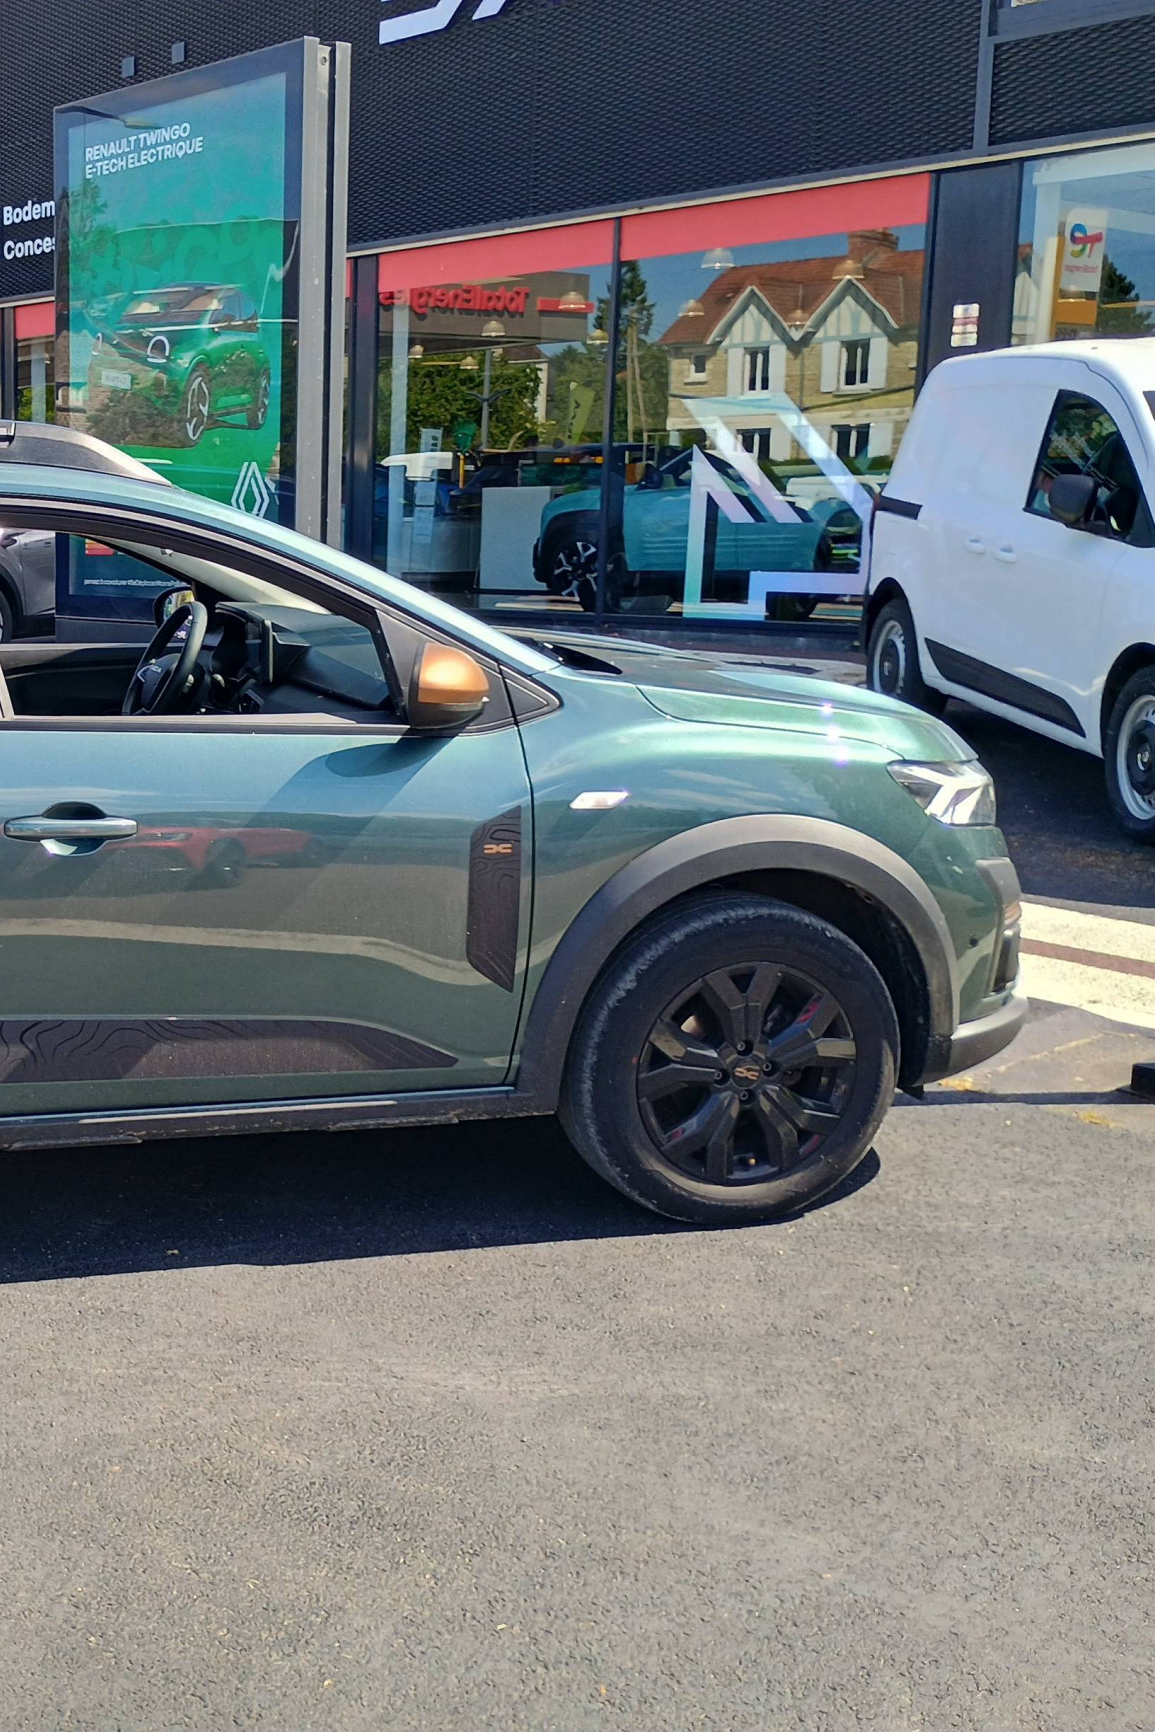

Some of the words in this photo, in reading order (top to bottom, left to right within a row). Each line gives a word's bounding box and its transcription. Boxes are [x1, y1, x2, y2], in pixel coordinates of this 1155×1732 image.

[85, 135, 137, 162] RENAULT
[138, 122, 191, 148] TWINGO
[85, 156, 127, 179] E-TECH
[127, 136, 204, 169] ELECTRIQUE
